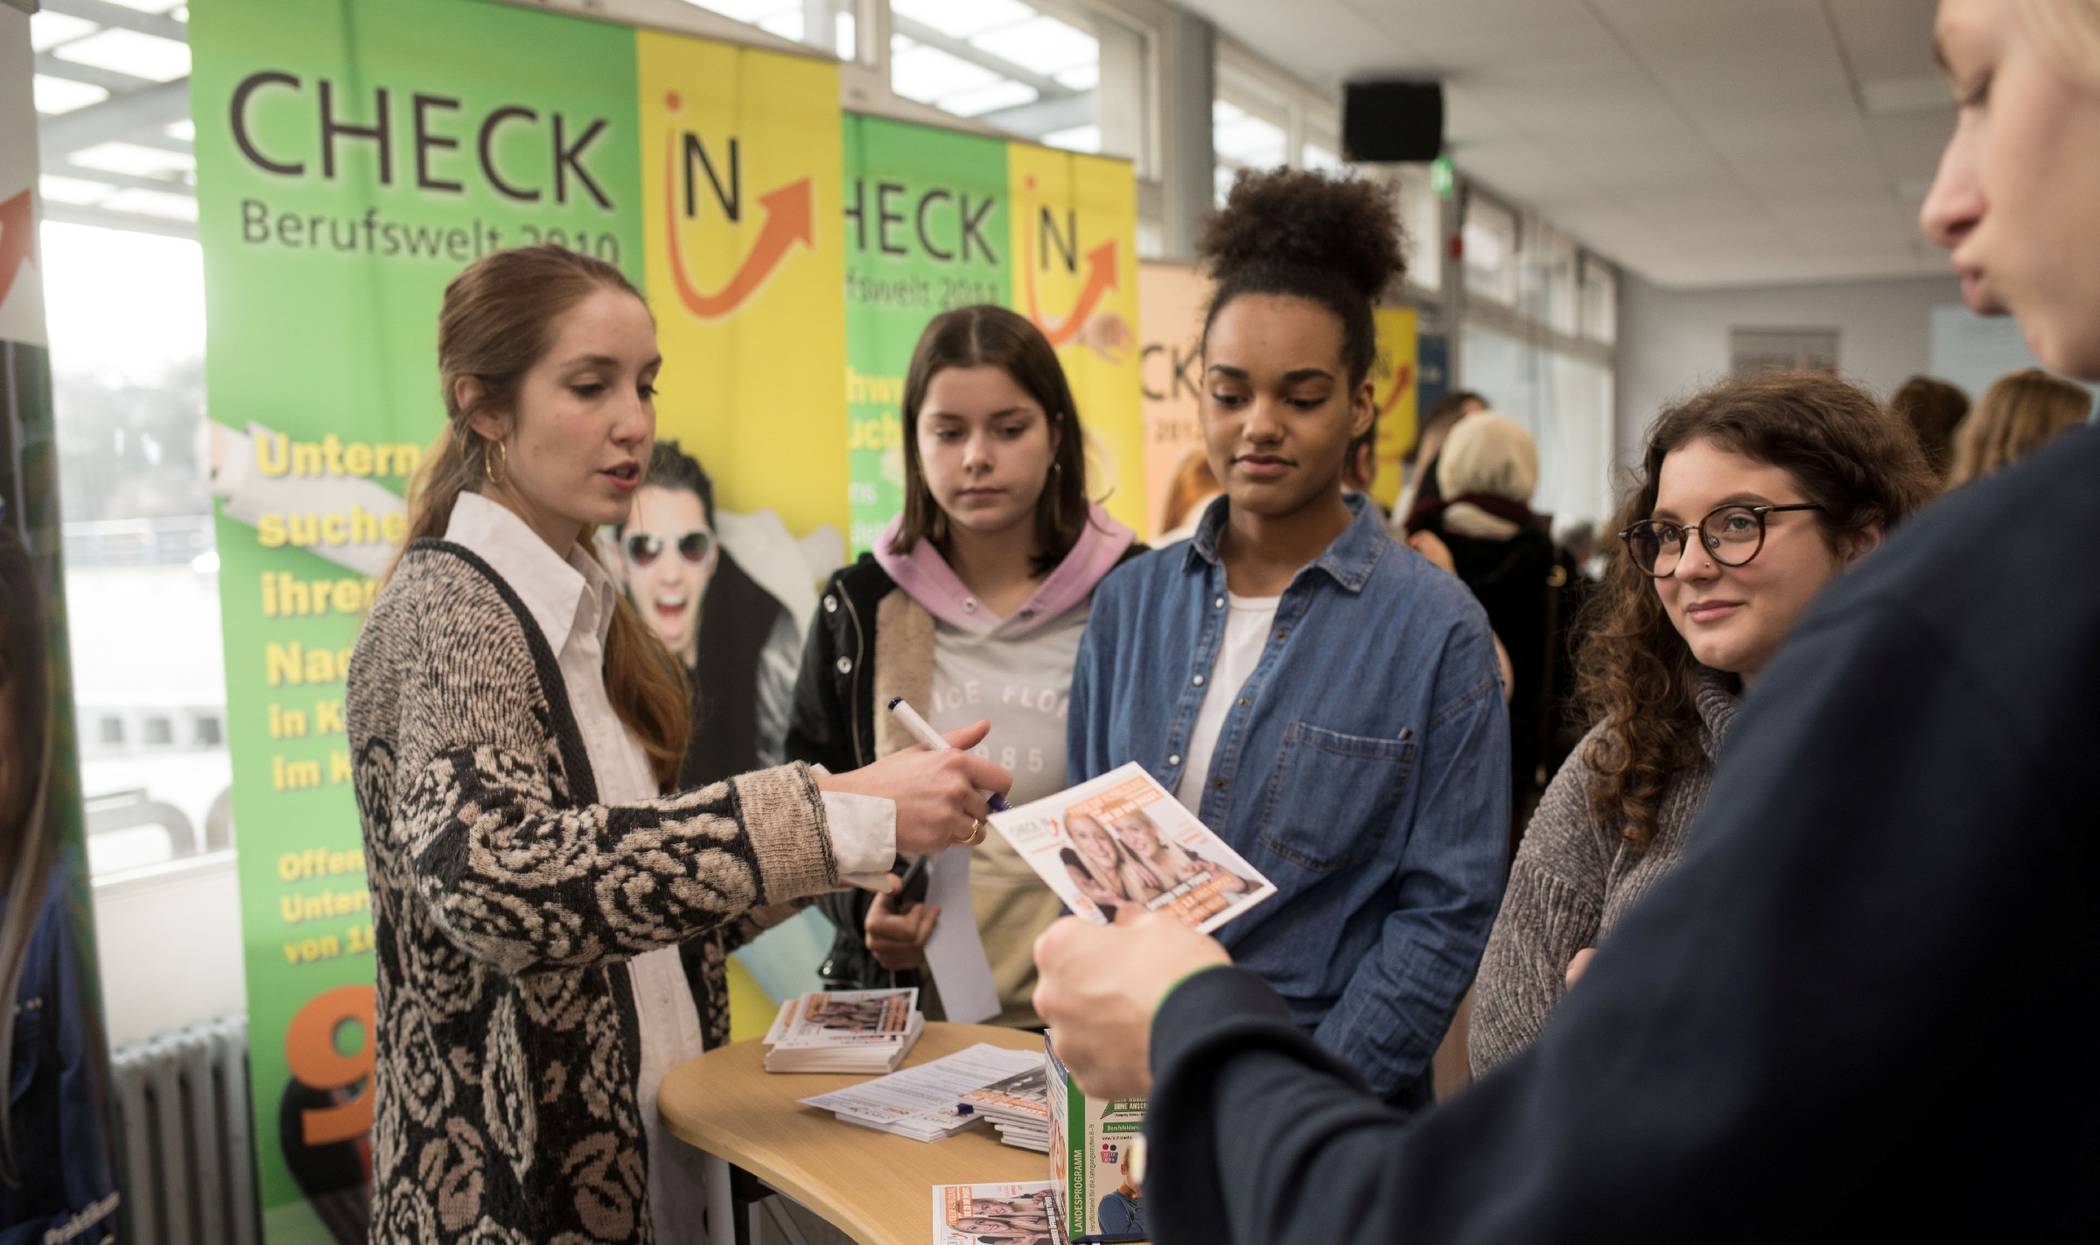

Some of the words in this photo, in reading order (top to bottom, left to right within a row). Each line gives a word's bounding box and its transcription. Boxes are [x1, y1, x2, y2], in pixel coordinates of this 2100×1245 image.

[229, 70, 615, 211] CHECK
[241, 198, 502, 262] Berufswelt
[256, 430, 420, 477] Untern
[257, 503, 408, 548] suche
[268, 703, 306, 738] in
[1074, 1149, 1083, 1233] LANDESPROGRAMM
